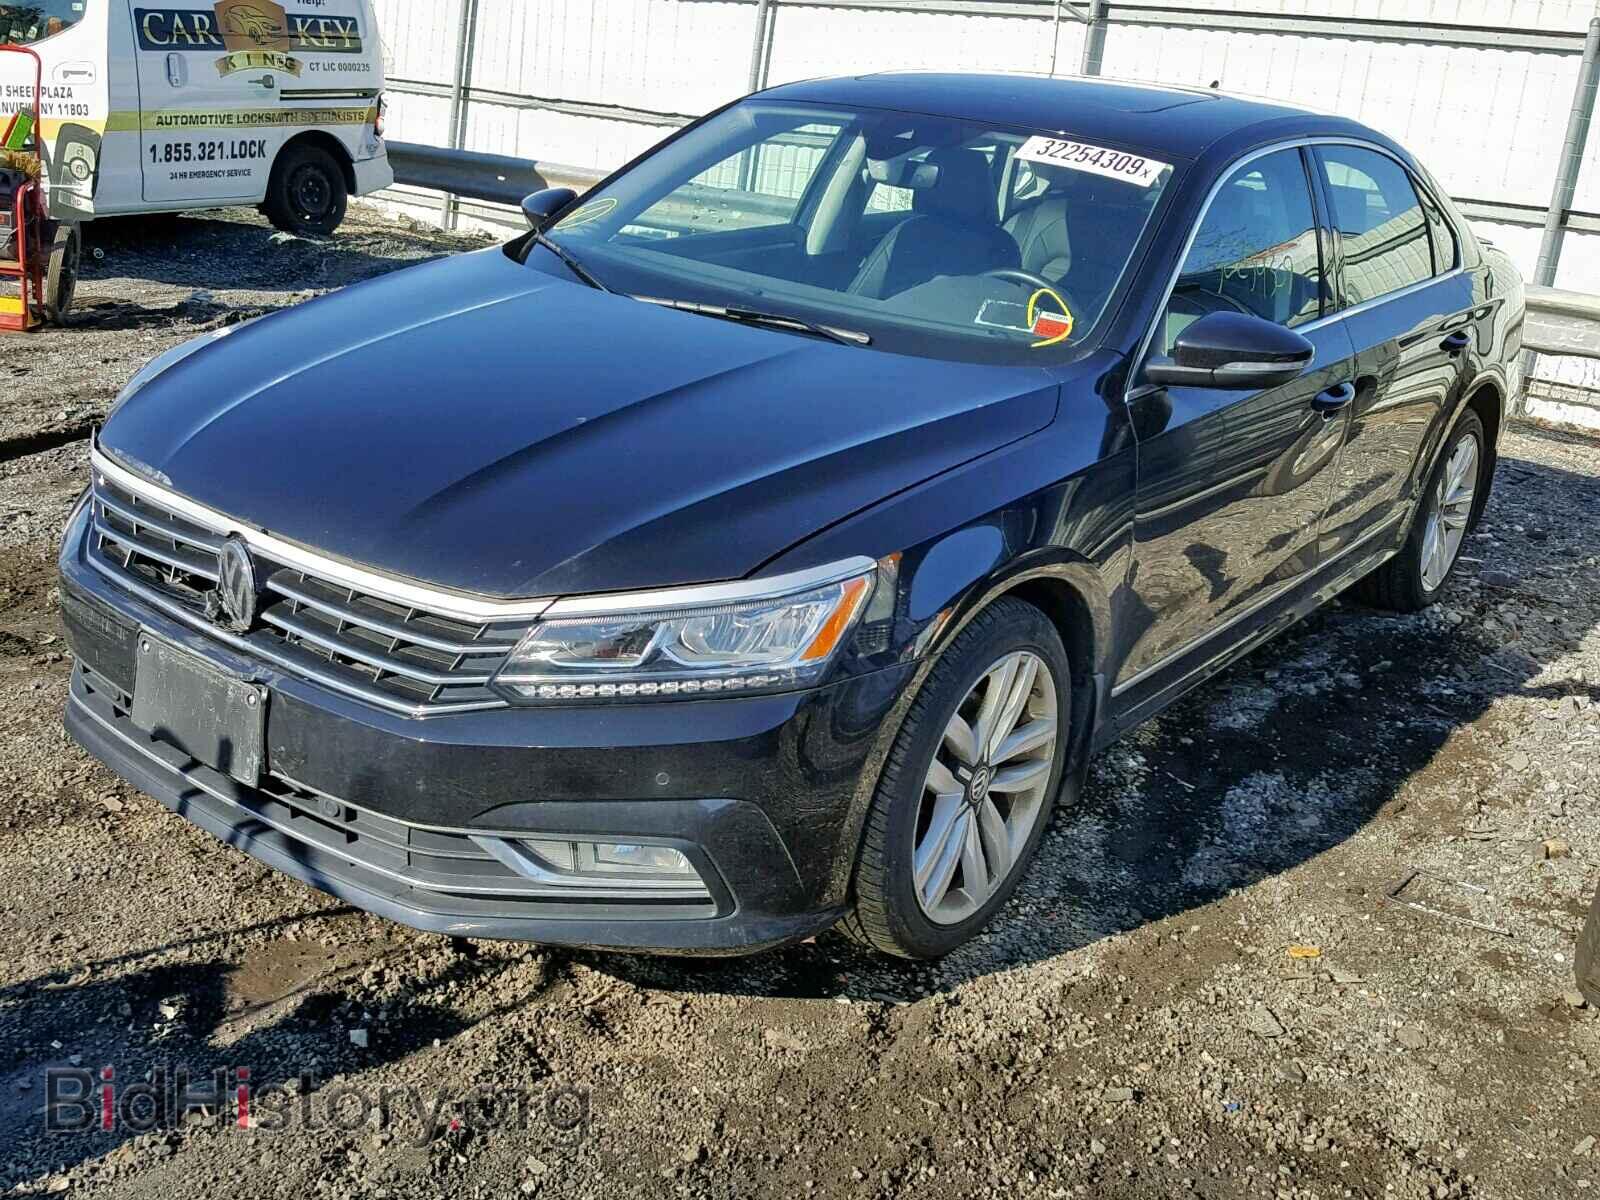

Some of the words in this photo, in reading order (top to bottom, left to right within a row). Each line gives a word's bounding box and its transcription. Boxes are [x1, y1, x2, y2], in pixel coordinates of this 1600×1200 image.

[142, 12, 223, 45] CAR
[294, 17, 354, 48] KEY
[309, 62, 320, 71] CT
[322, 62, 336, 71] LIC
[41, 86, 73, 99] PLAZA
[41, 103, 53, 115] NY
[58, 103, 89, 116] 11803
[156, 113, 233, 126] AUTOMOTIVE
[236, 112, 297, 124] LOCKSMITH
[300, 110, 364, 122] SPECIALISTS
[149, 139, 266, 164] 1.855.321.LOCK
[169, 172, 178, 180] 24
[178, 171, 187, 180] HR
[189, 169, 226, 179] EMERGENCY
[226, 168, 252, 177] SERVICE
